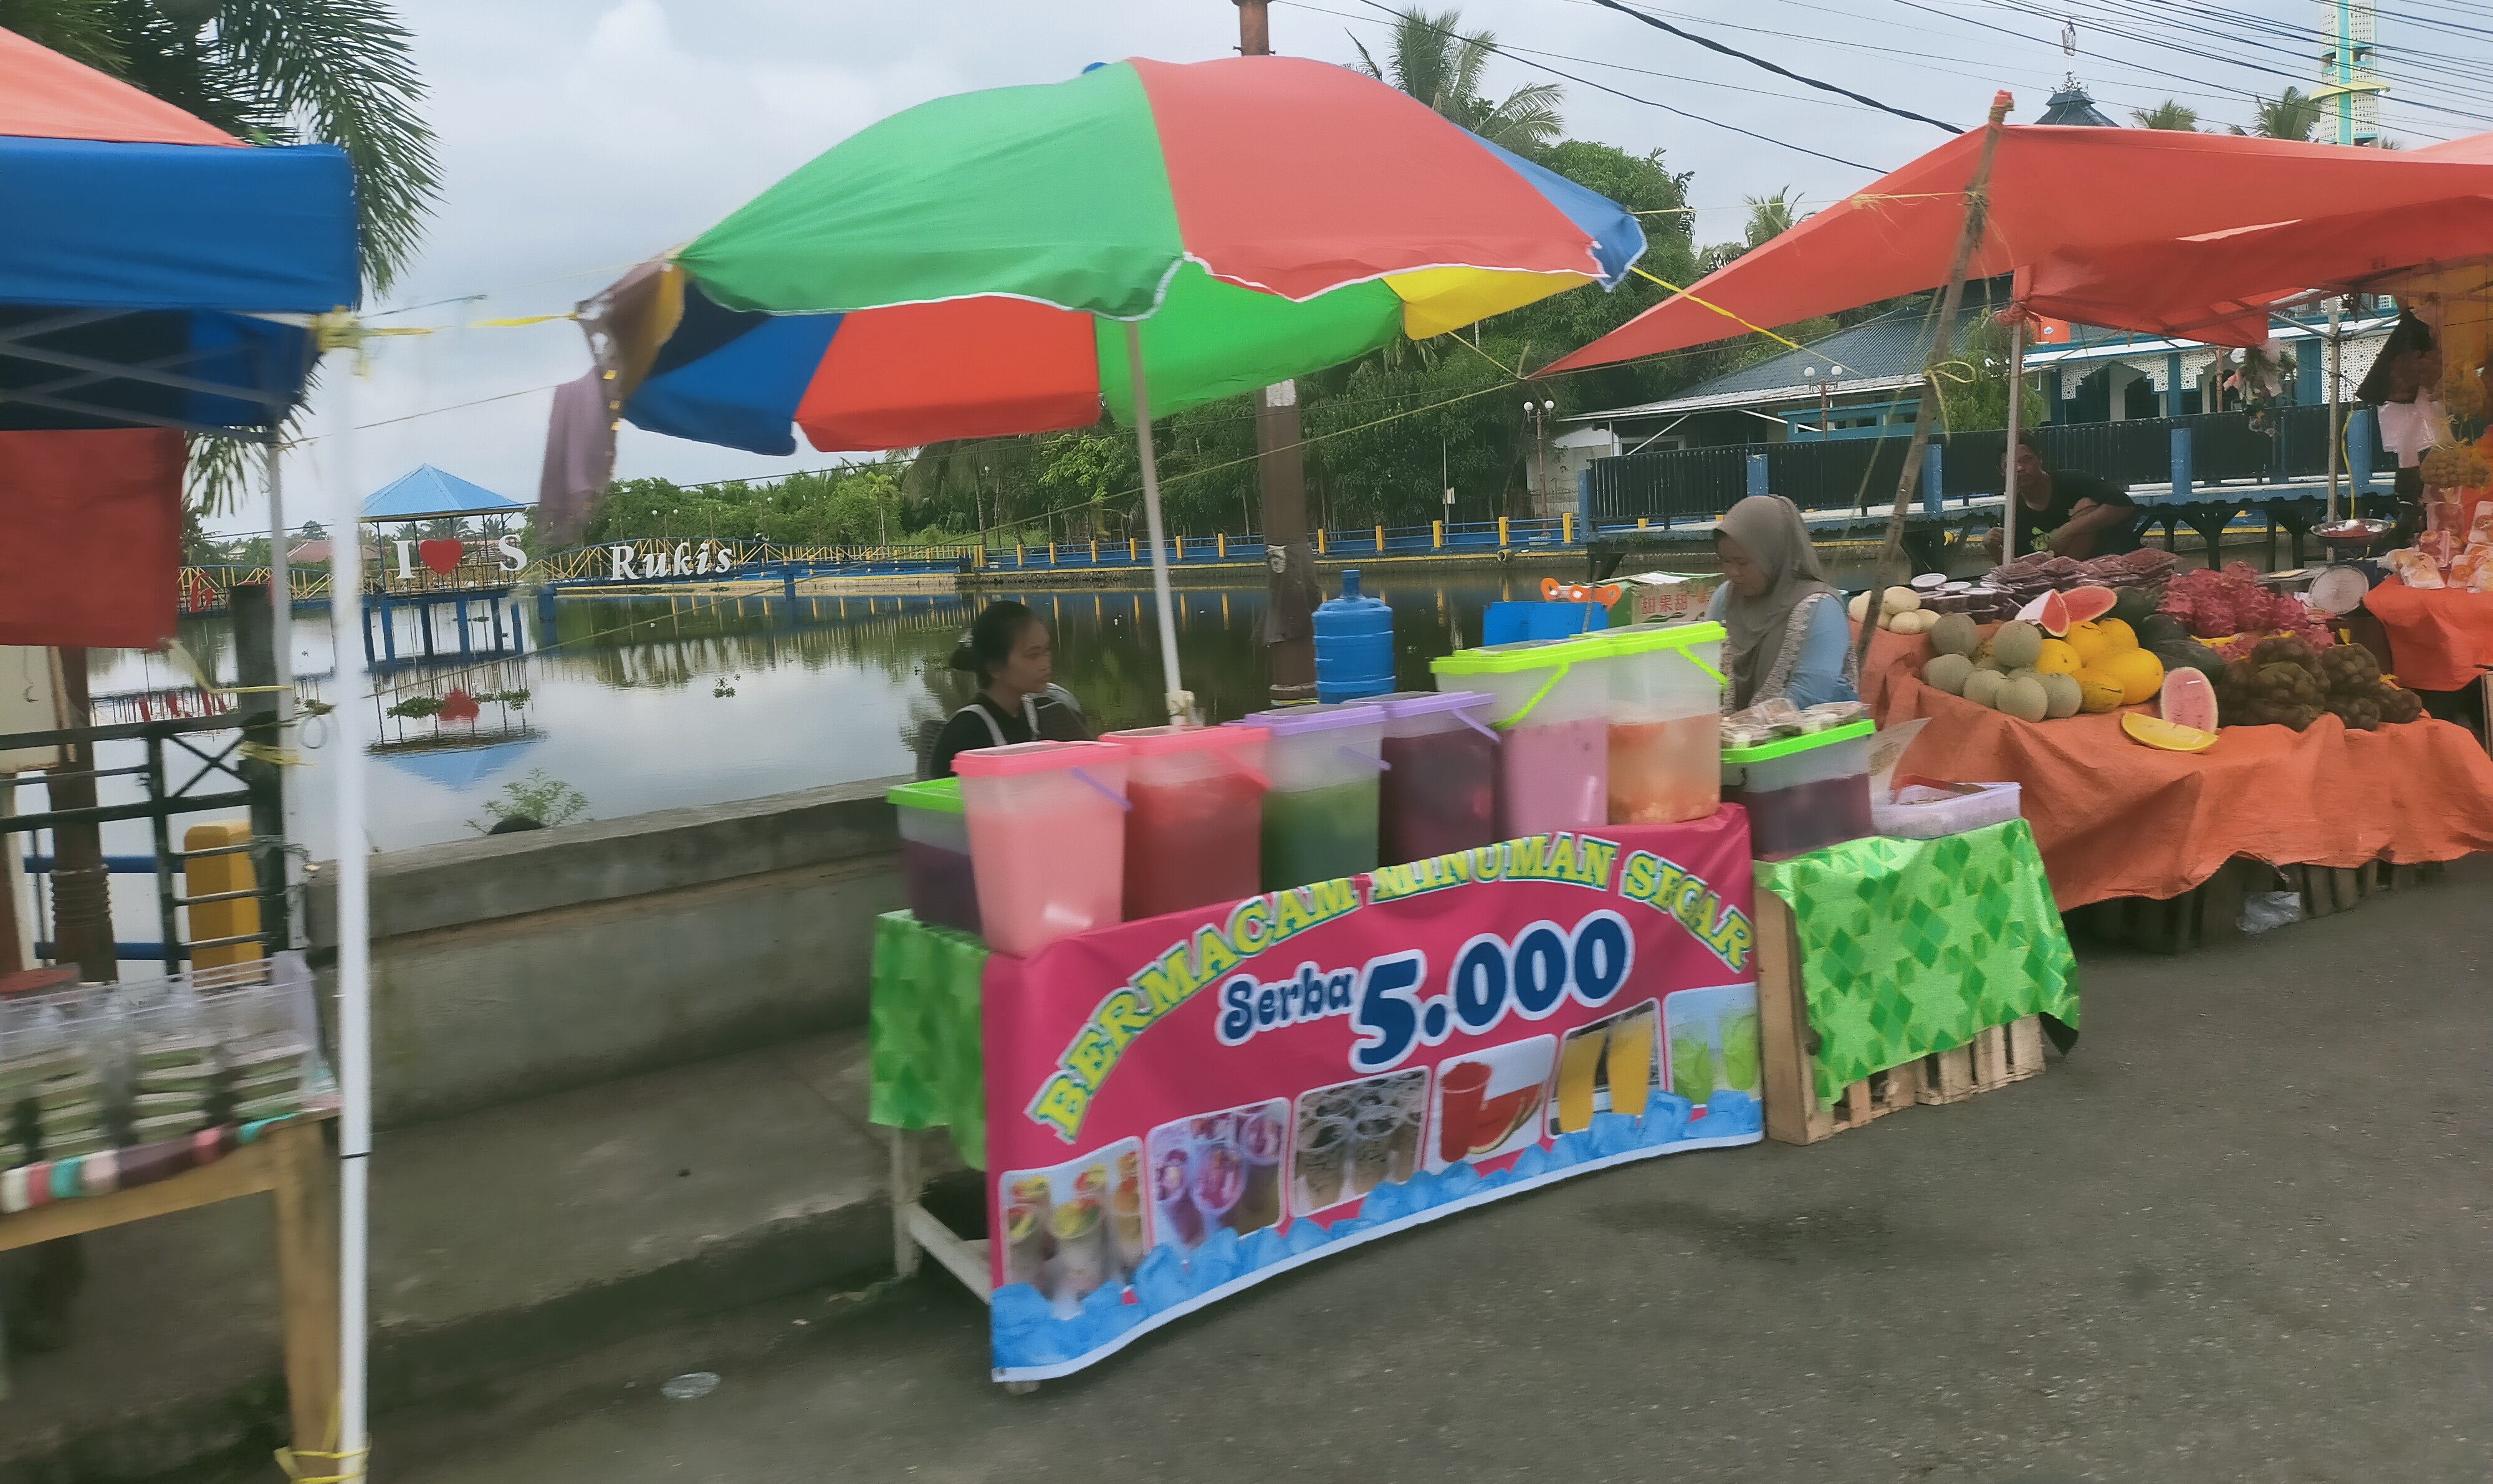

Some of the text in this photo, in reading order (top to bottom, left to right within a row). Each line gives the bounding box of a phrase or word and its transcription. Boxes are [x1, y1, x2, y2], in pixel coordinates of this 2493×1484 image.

[391, 540, 414, 579] I
[608, 542, 733, 581] Rukis
[1023, 876, 1366, 1144] BERMACAM
[1619, 850, 1754, 973] SEGAR
[1216, 910, 1635, 1073] Serba 5.000
